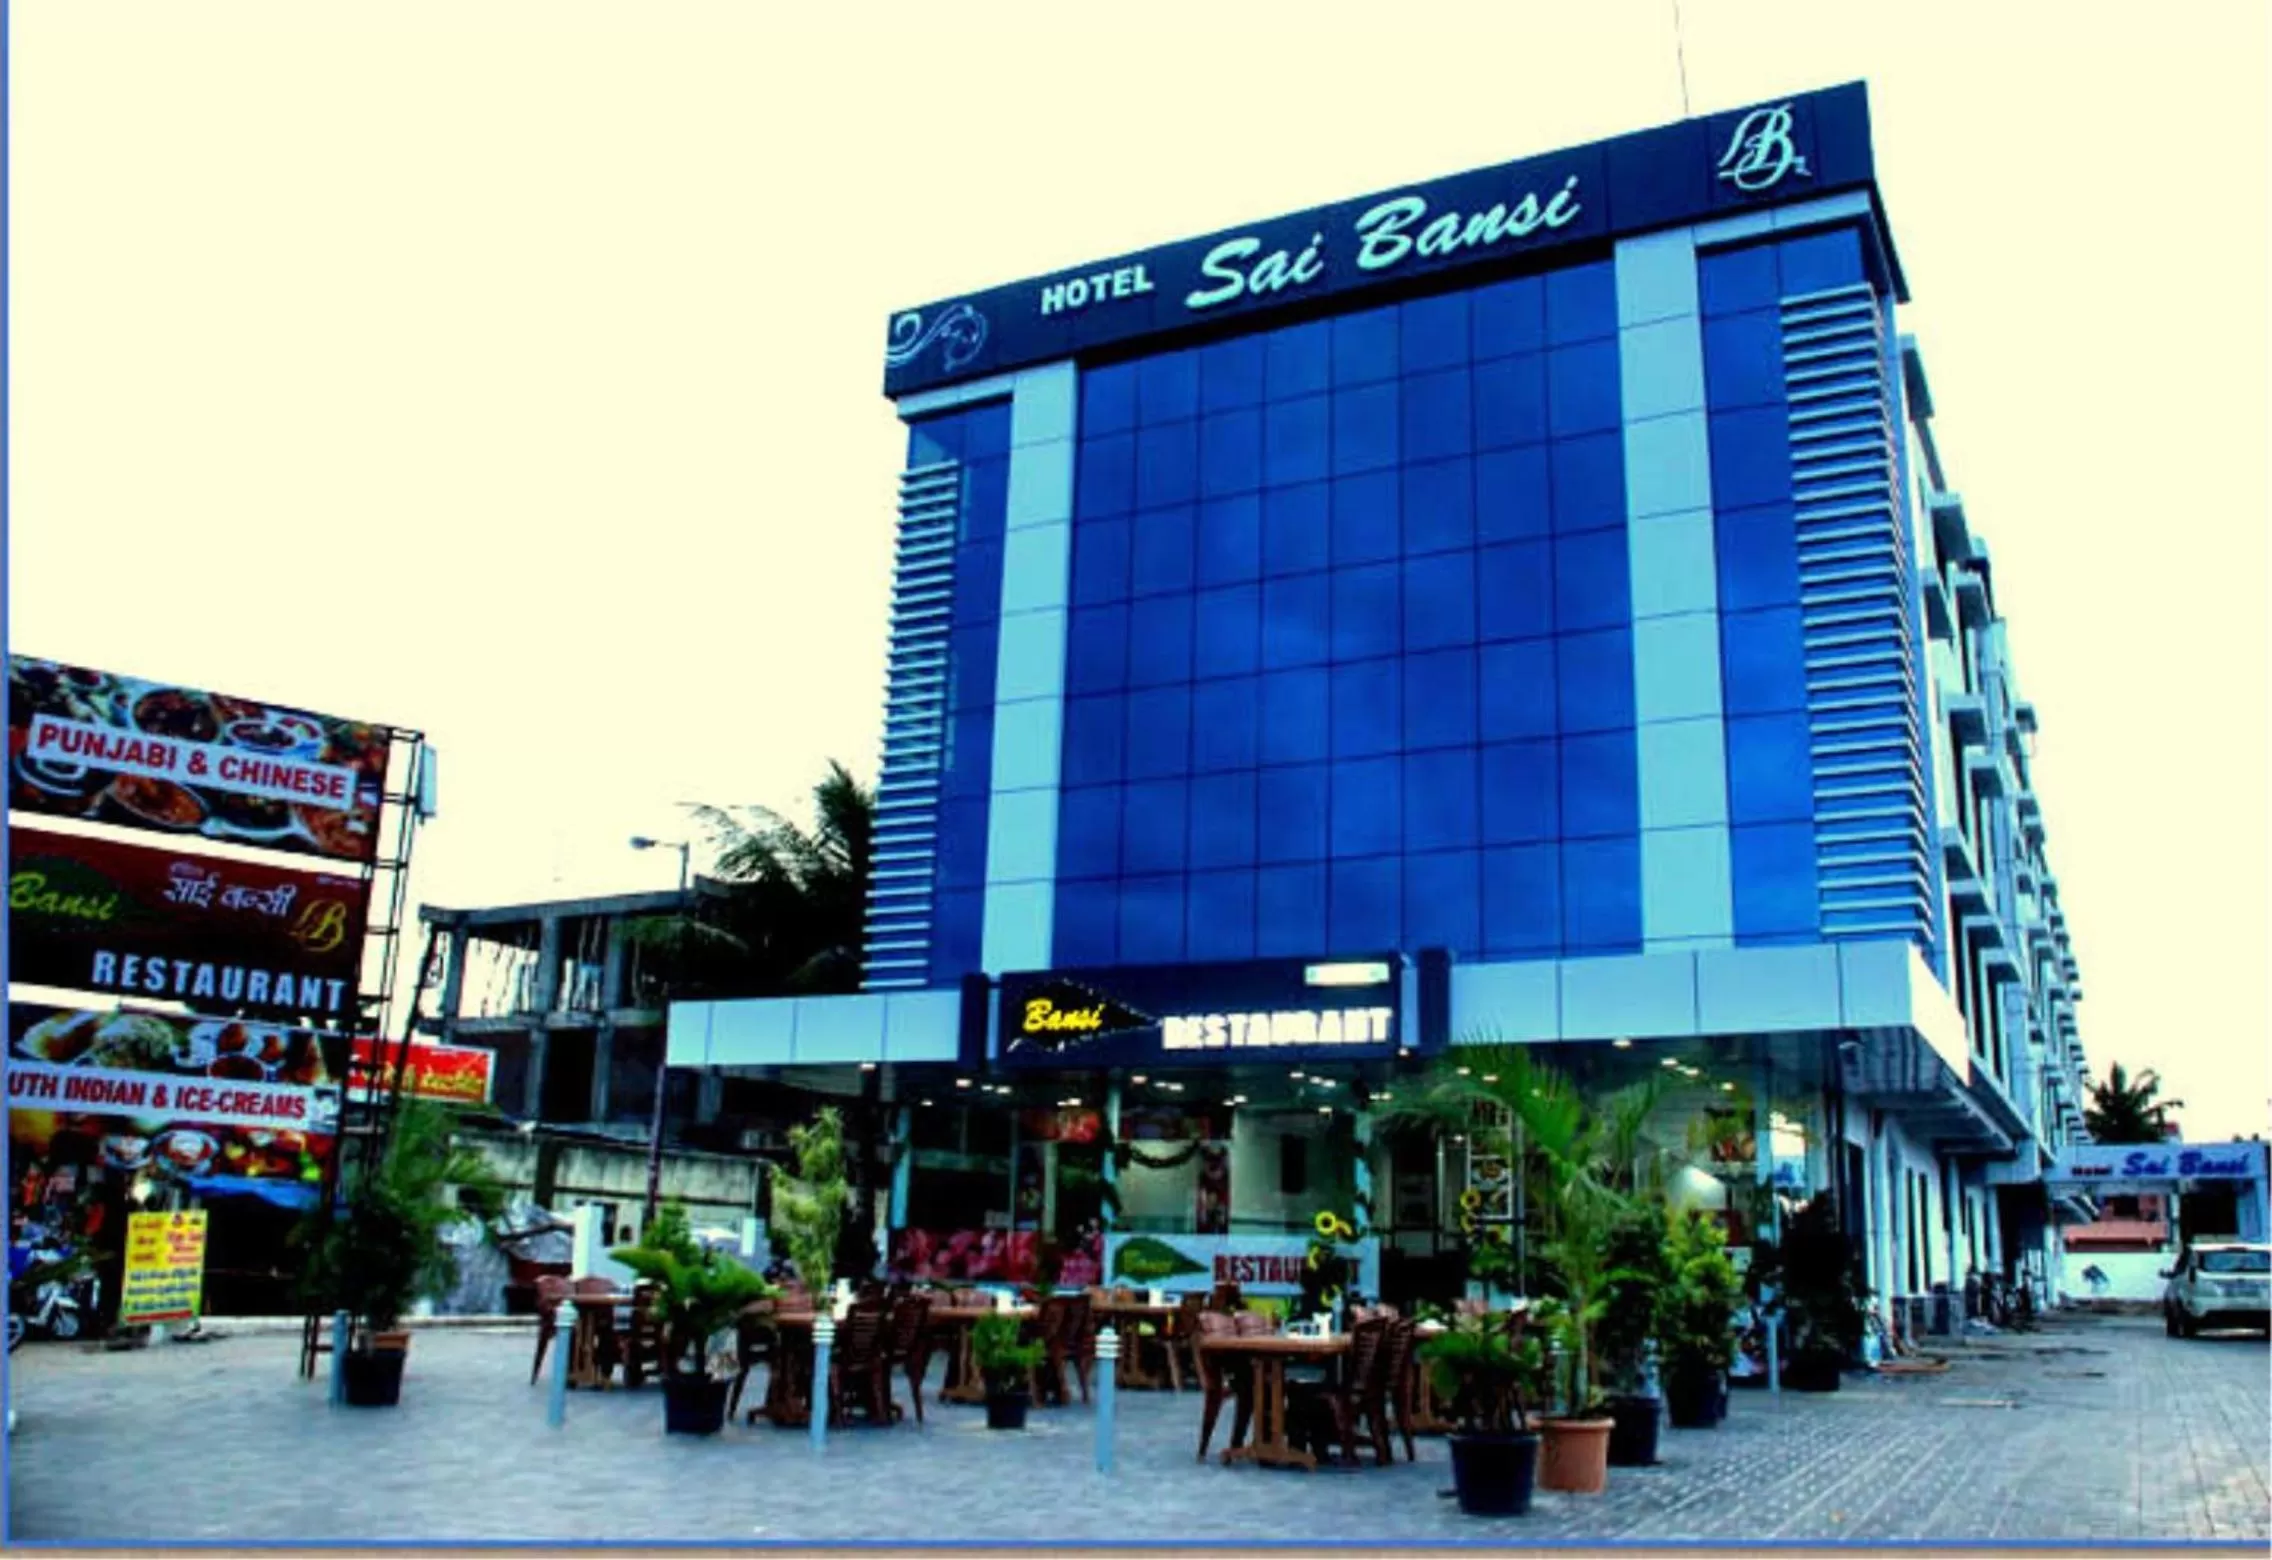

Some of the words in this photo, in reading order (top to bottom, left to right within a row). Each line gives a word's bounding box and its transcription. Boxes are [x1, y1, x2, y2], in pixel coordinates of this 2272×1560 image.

[1040, 264, 1154, 316] HOTEL
[1185, 231, 1325, 309] Sai
[1354, 174, 1581, 270] Bansi
[36, 722, 177, 771] PUNJABI
[186, 748, 209, 776] &
[218, 754, 347, 799] CHINESE
[9, 871, 120, 921] Bansi
[91, 950, 347, 1012] RESTAURANT
[1022, 997, 1106, 1032] Bansi
[1160, 1006, 1393, 1050] RESTAURANT
[8, 1070, 58, 1099] UTH
[64, 1075, 147, 1107] INDIAN
[152, 1083, 168, 1109] &
[174, 1085, 306, 1120] ICE-CREAMS
